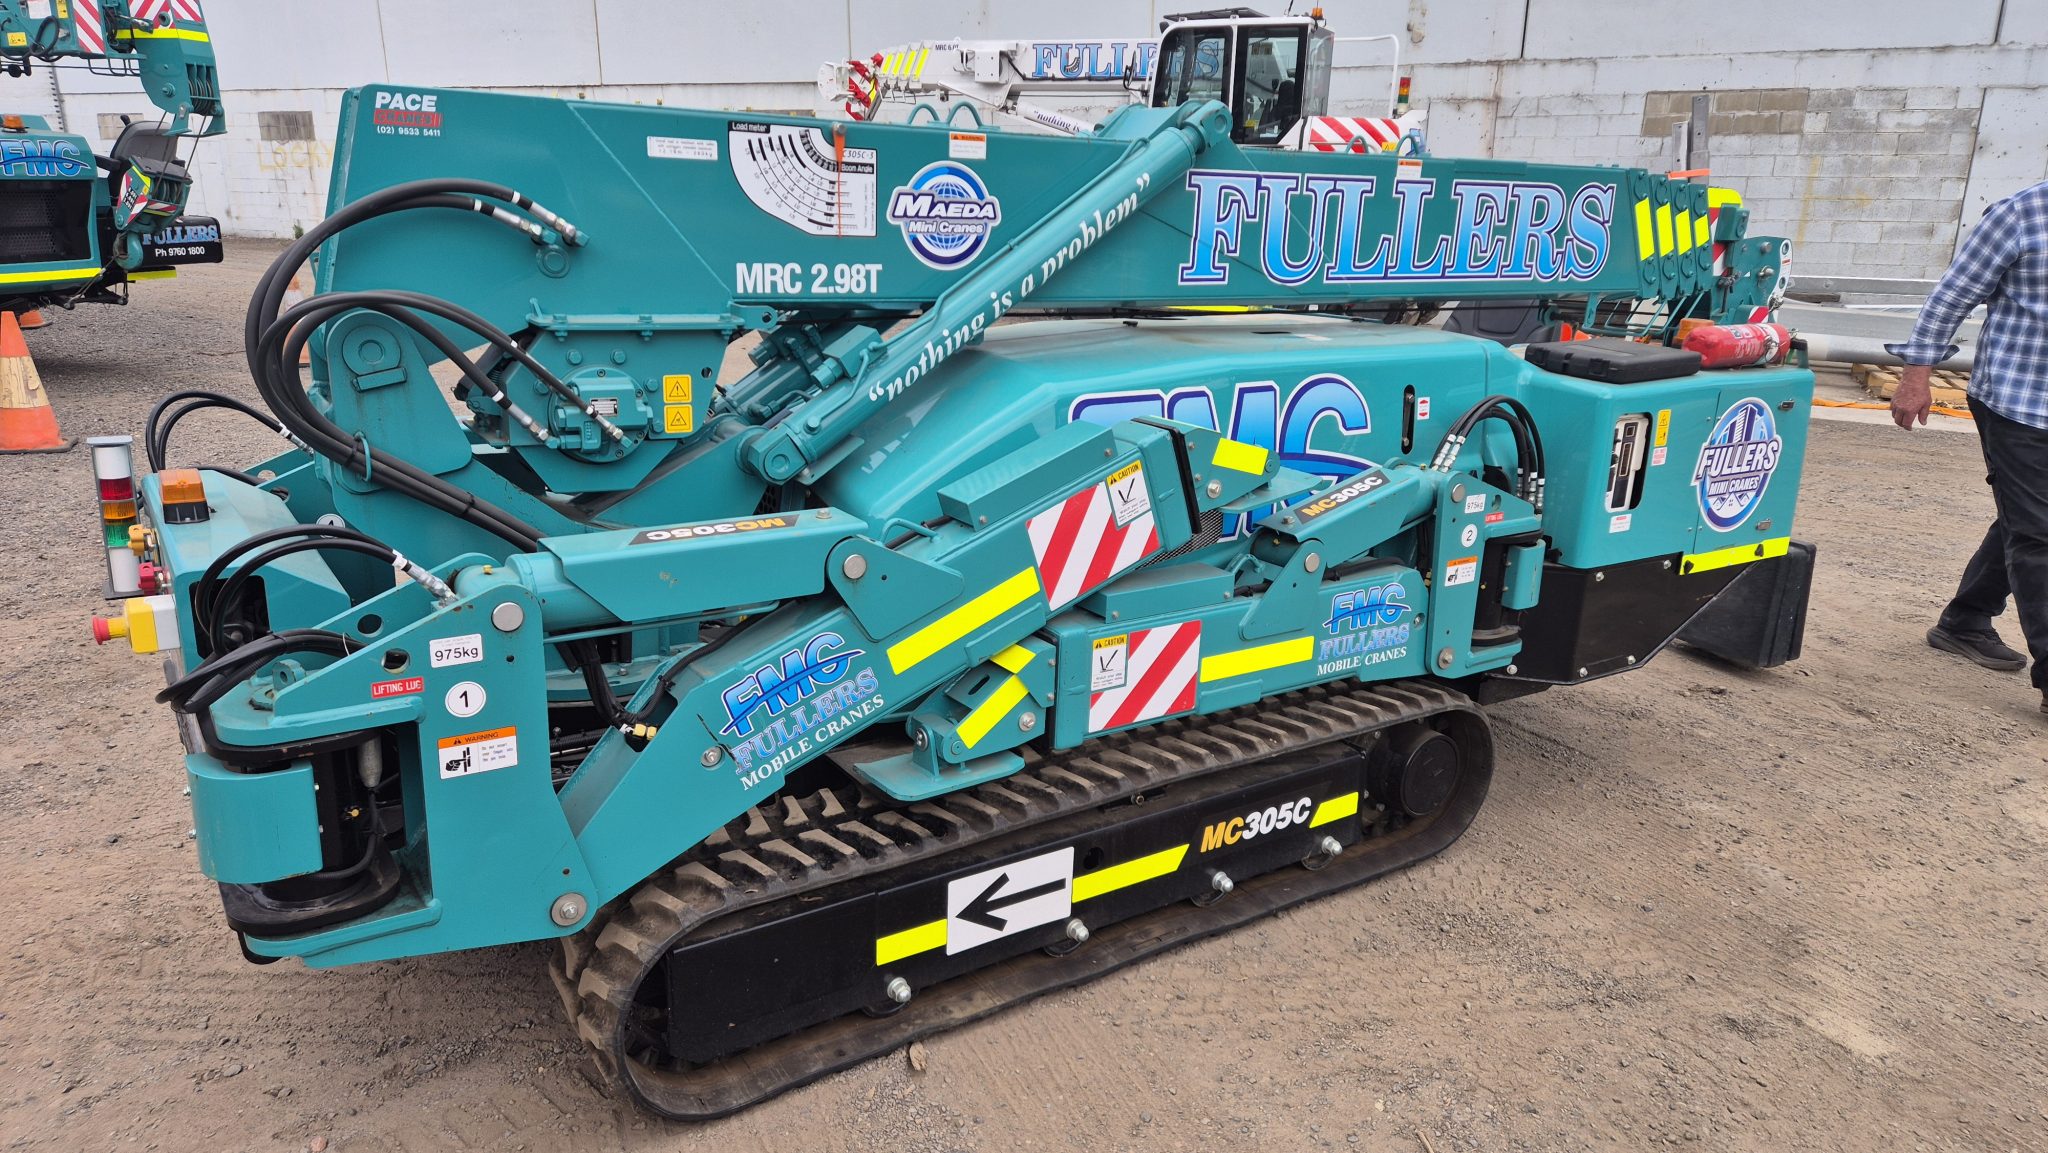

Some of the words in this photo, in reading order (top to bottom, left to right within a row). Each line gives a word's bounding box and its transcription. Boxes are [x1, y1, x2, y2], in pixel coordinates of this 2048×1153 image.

[374, 91, 438, 112] PACE
[377, 125, 395, 135] (02)
[398, 126, 420, 136] 9533
[423, 127, 441, 137] 5411
[732, 121, 748, 132] Load
[749, 123, 767, 132] meter
[857, 164, 873, 173] Angle
[908, 221, 936, 233] Mini
[938, 221, 984, 234] Cranes
[1178, 169, 1617, 285] FULLERS
[155, 248, 167, 257] Ph
[169, 247, 186, 257] 9760
[188, 246, 205, 256] 1800
[736, 262, 802, 294] MRC
[810, 263, 883, 294] 2.98T
[990, 291, 1013, 320] is
[1020, 272, 1035, 297] a
[1696, 440, 1779, 480] FULLERS
[1117, 463, 1139, 480] CAUTION
[1301, 476, 1383, 516] MC305C
[1708, 479, 1730, 497] MINI
[1729, 475, 1760, 494] CRANES
[646, 517, 786, 541] MC305C
[1466, 529, 1473, 541] 2
[1322, 582, 1412, 635] FMC
[1104, 636, 1125, 647] CAUTION
[1318, 623, 1410, 661] FULLERS
[434, 646, 479, 662] 975kg
[1317, 656, 1361, 677] MOBILE
[1365, 646, 1407, 665] CRANES
[373, 682, 403, 696] LIFTING
[719, 632, 866, 737] FMC
[458, 690, 469, 708] 1
[731, 667, 879, 775] FULLERS
[465, 731, 499, 743] WARNING
[739, 737, 813, 791] MOBILE
[814, 694, 884, 743] CRANES
[1200, 797, 1312, 853] MC305C
